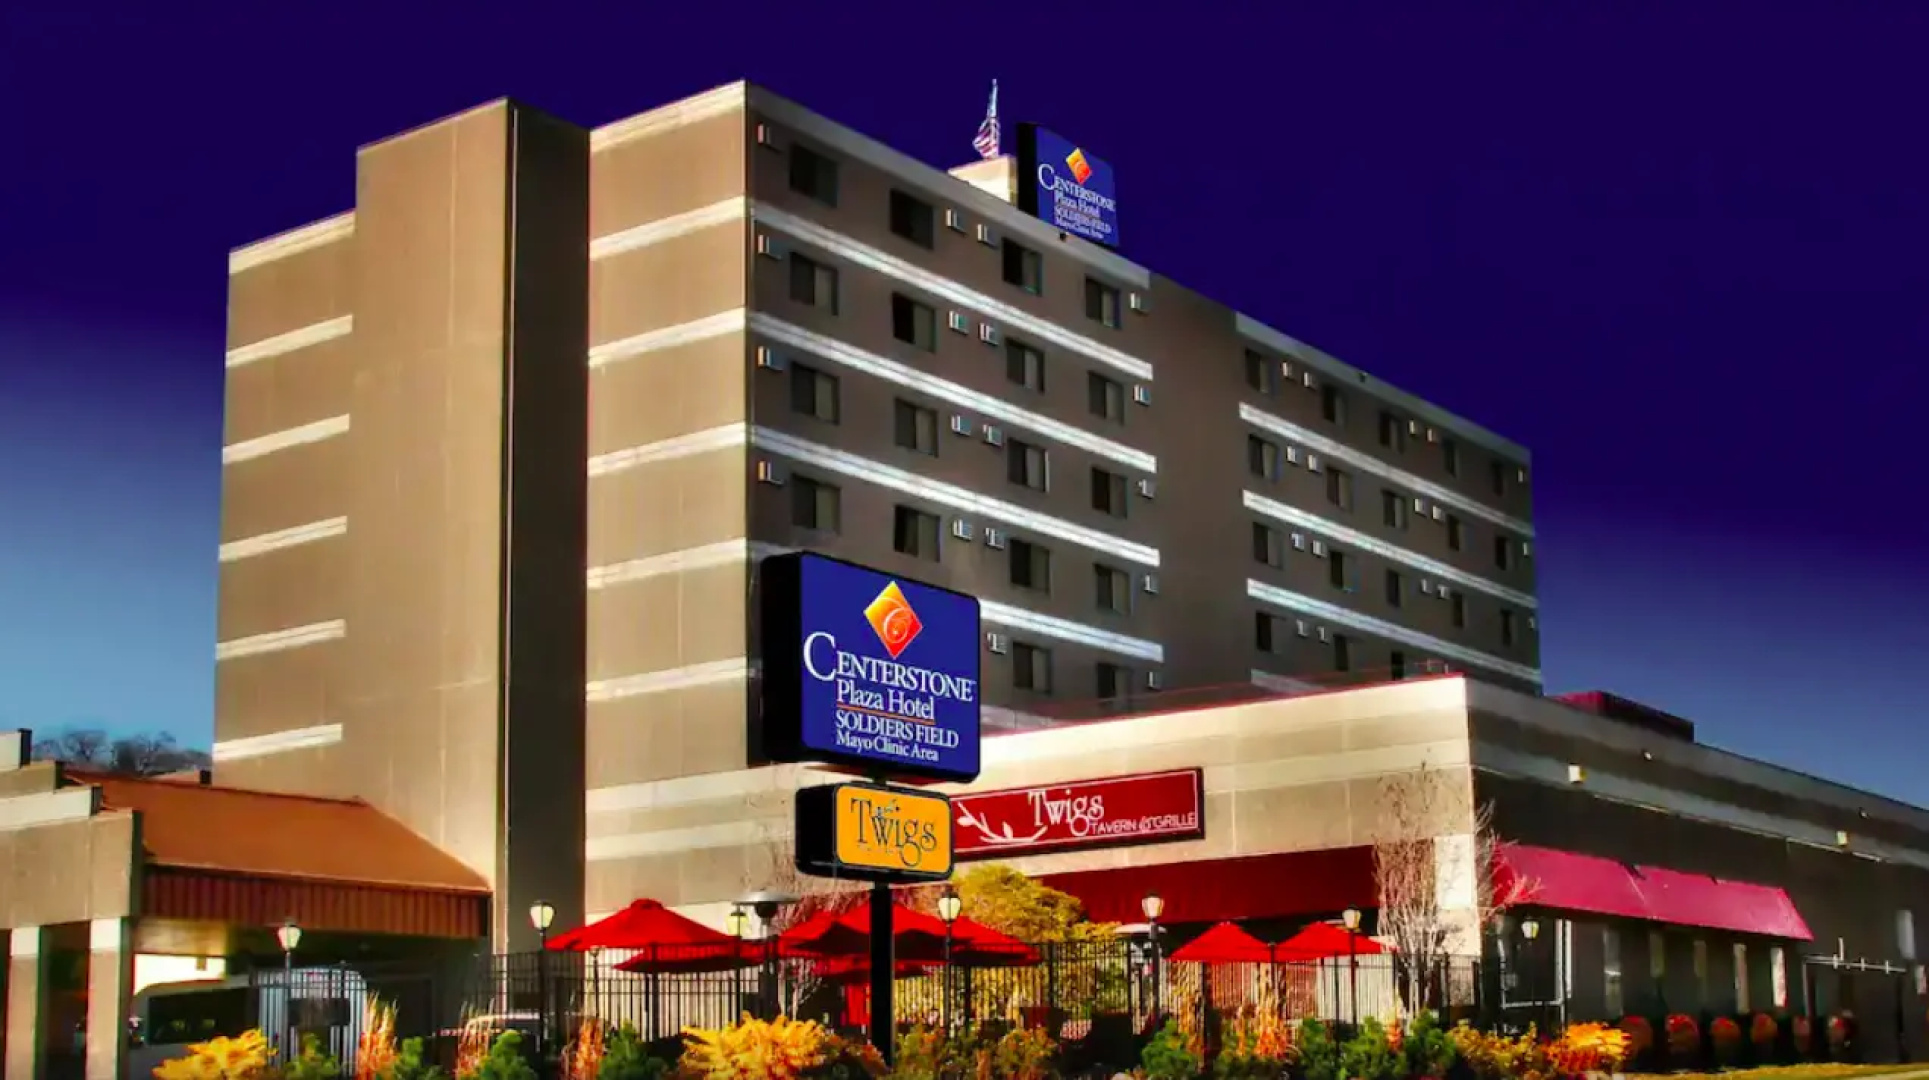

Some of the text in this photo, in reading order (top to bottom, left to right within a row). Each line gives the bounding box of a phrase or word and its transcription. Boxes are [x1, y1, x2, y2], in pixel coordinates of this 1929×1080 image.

[1038, 163, 1116, 212] CENTERSTONE
[803, 631, 973, 702] CENTERSTONE
[836, 678, 935, 720] Plaza Hotel
[836, 708, 959, 749] SOLDIERS FIELD
[836, 728, 940, 762] Mayo Clinic Area
[851, 798, 937, 867] Twigs
[1028, 788, 1104, 837] Twigs
[1089, 818, 1137, 835] TAVERN
